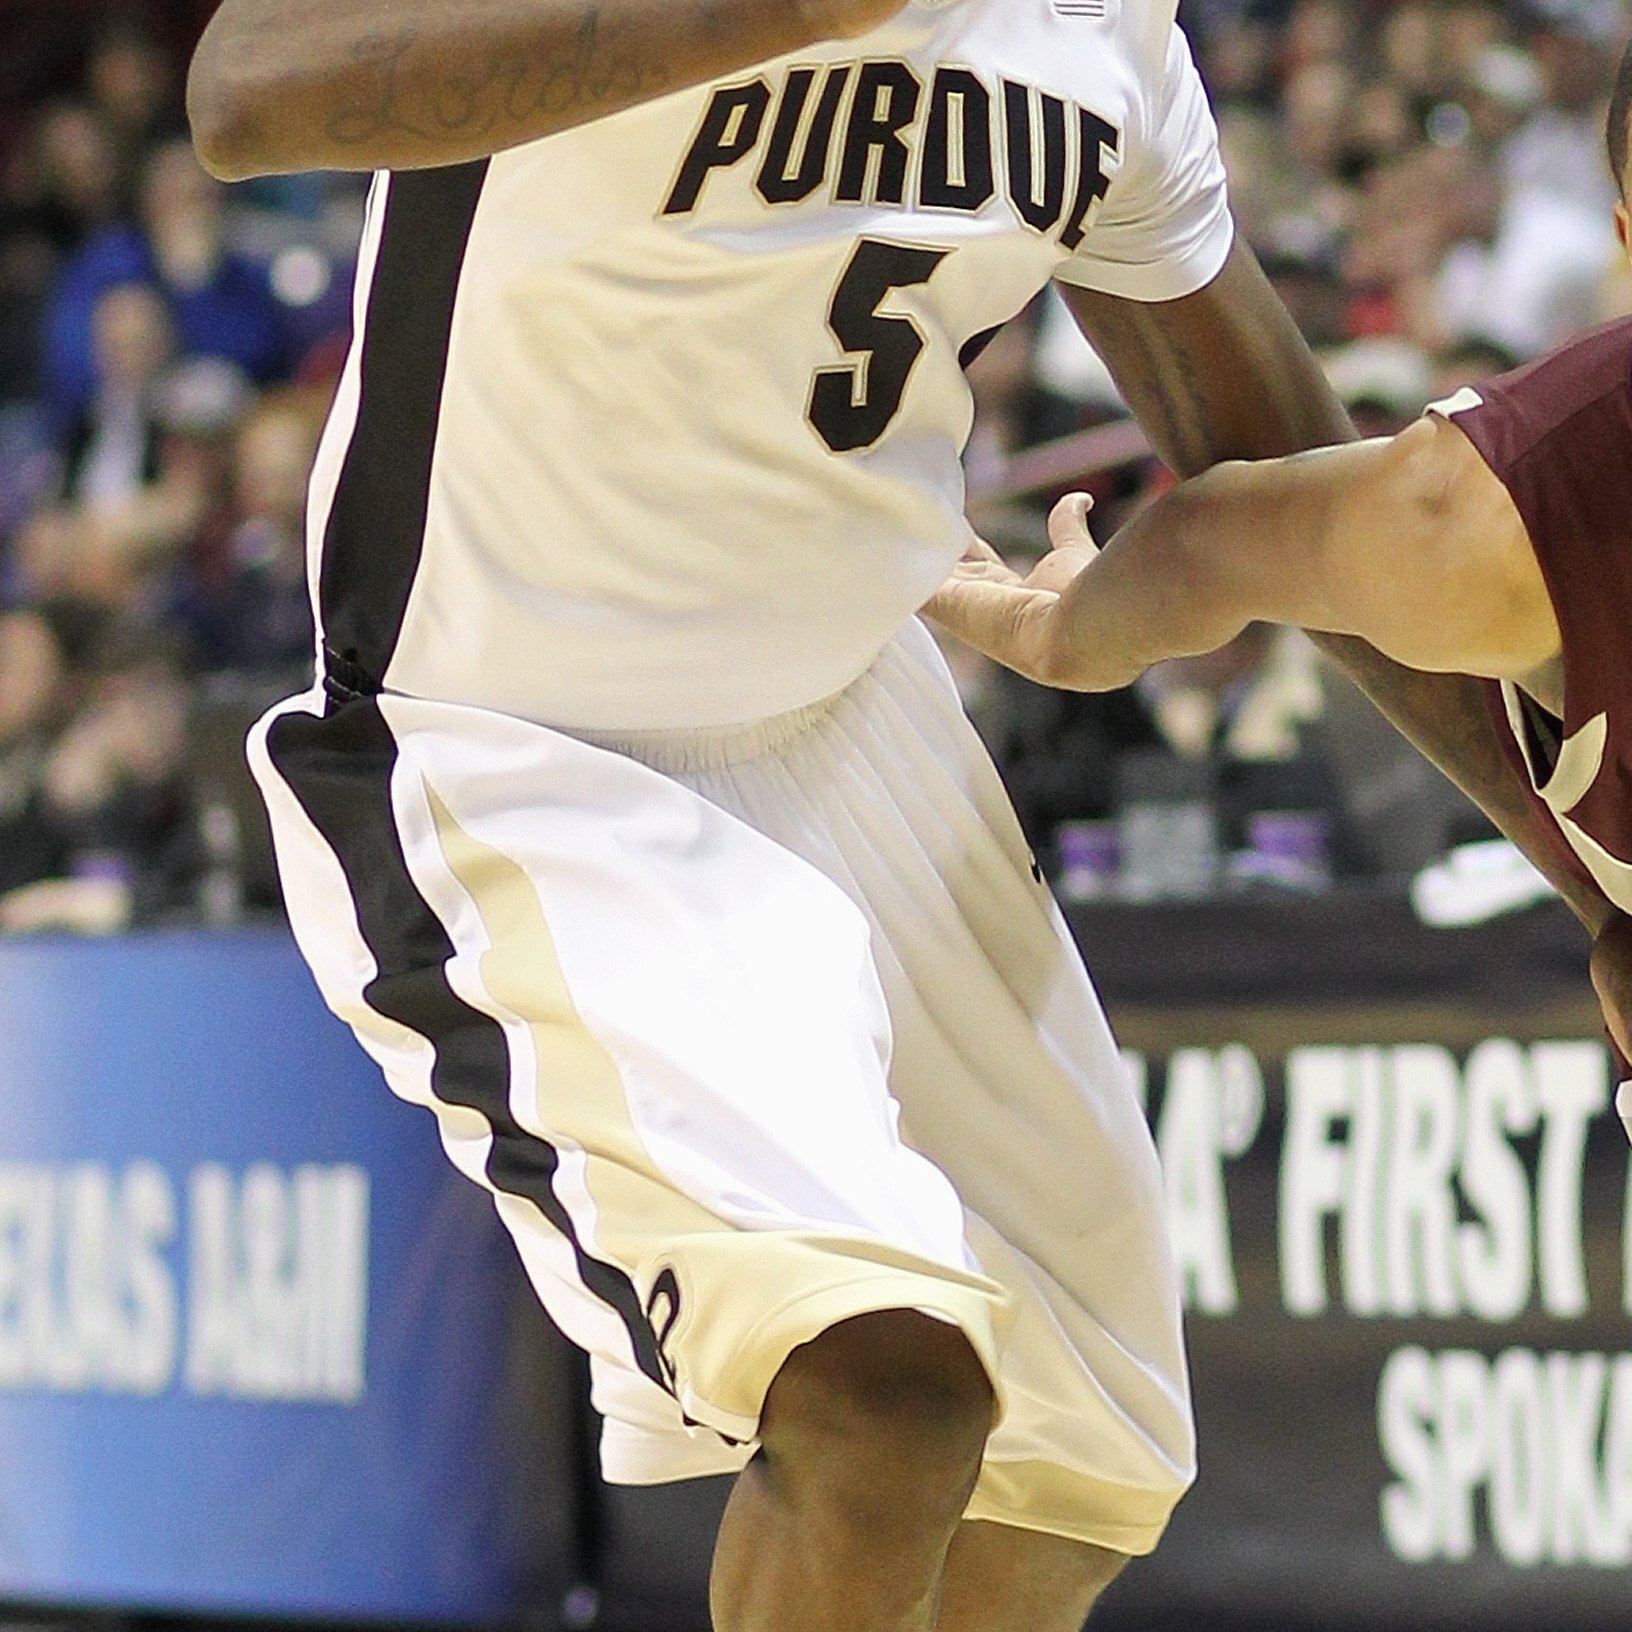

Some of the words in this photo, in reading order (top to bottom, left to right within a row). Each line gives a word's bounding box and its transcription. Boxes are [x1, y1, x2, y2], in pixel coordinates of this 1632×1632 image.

[655, 55, 1121, 257] PURDUE
[804, 236, 958, 454] 5
[1280, 1038, 1611, 1320] FIRST
